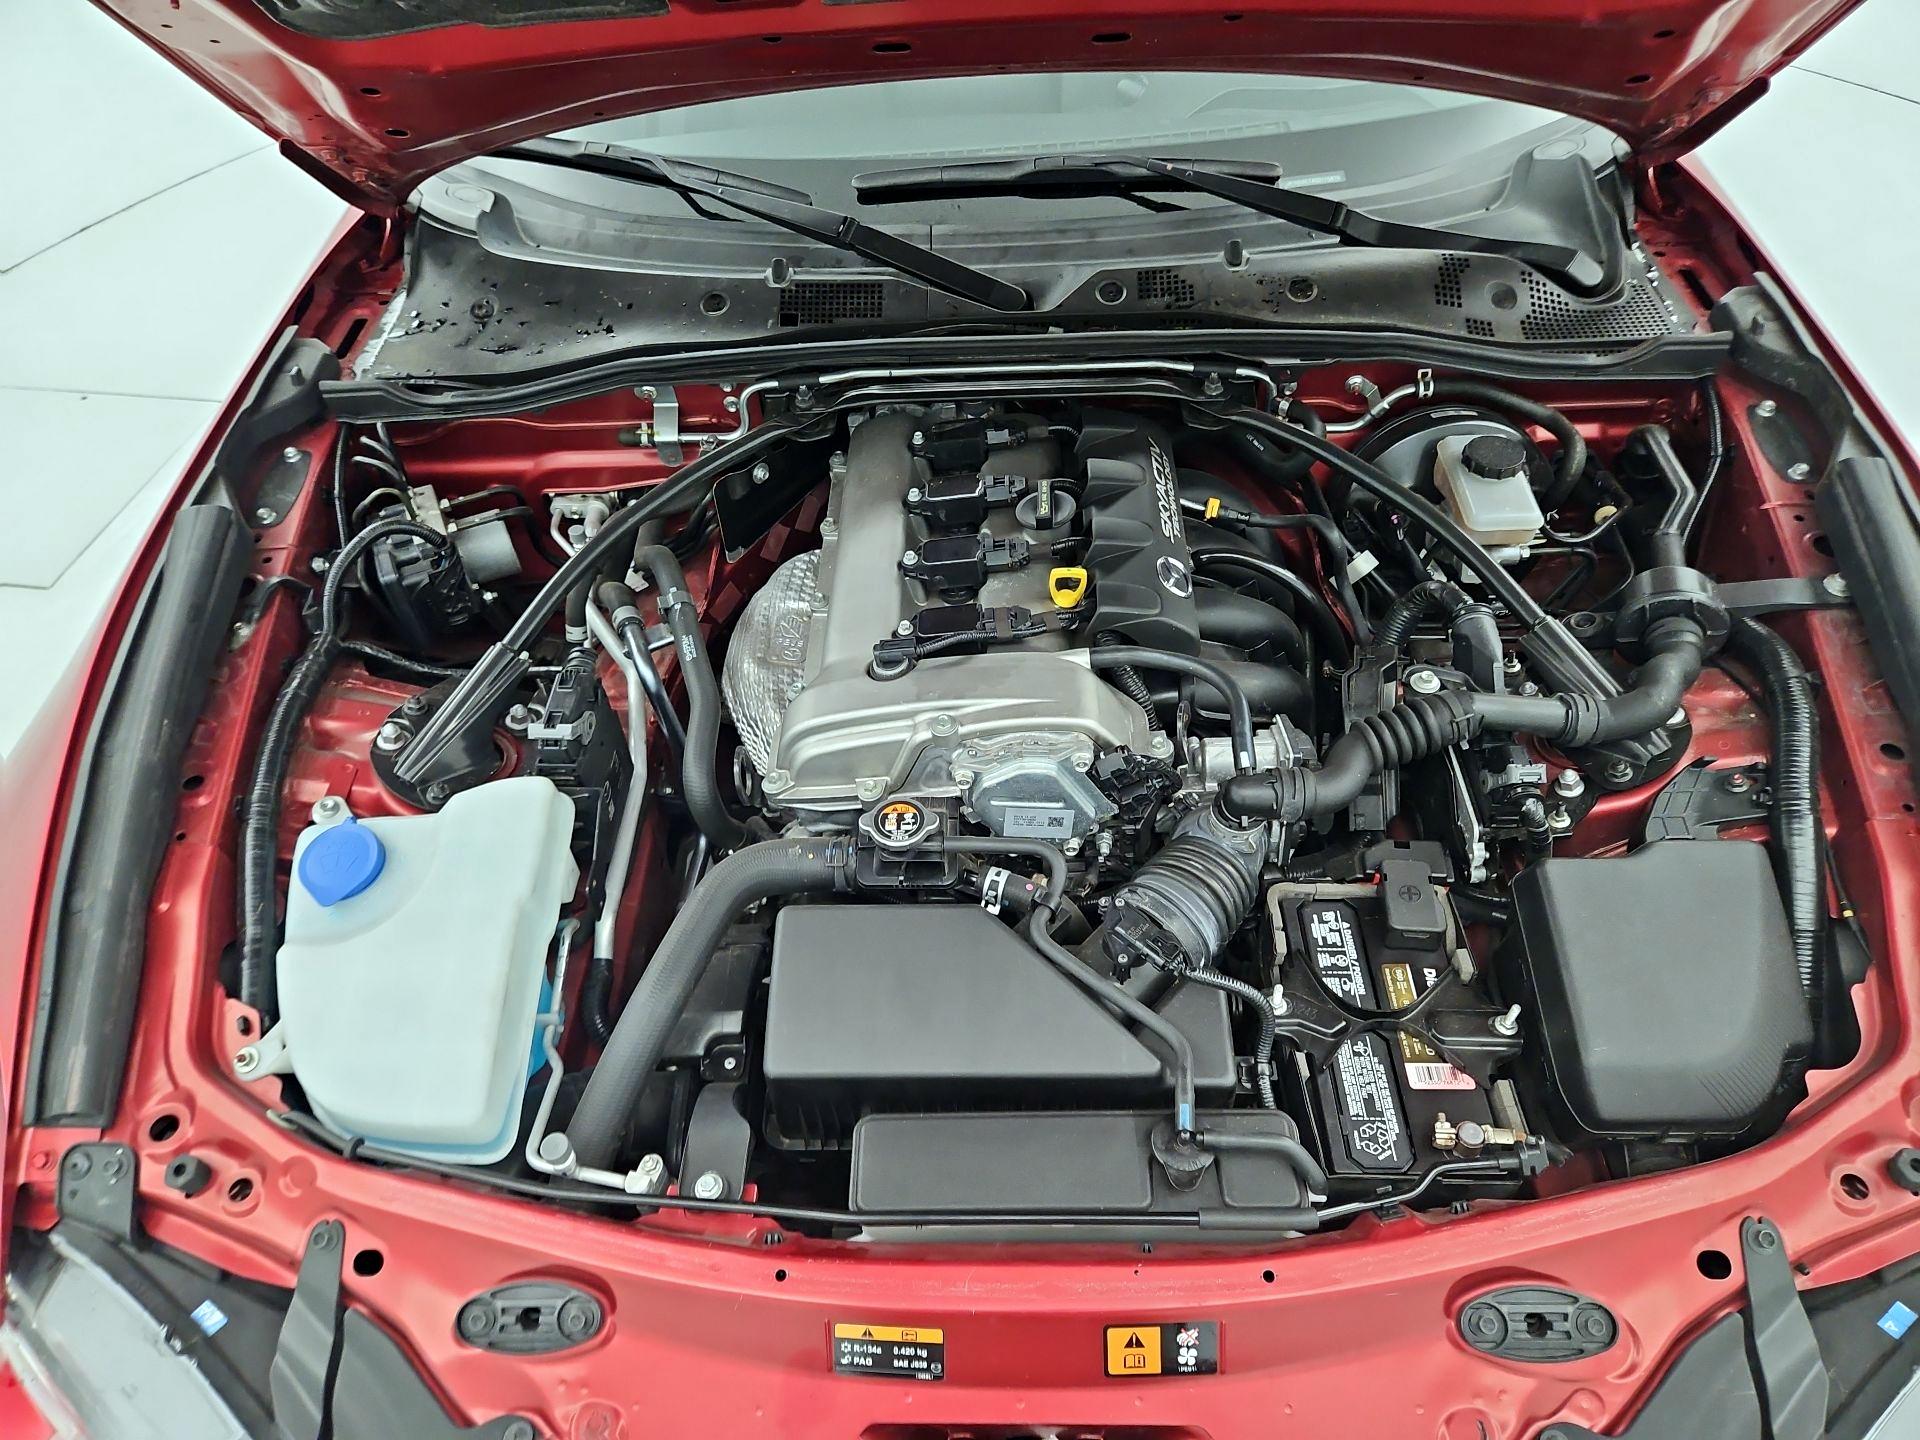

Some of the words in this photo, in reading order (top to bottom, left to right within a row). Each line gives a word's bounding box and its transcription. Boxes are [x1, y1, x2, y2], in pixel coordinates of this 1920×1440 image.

[1148, 436, 1174, 544] SKYACTIV
[1162, 451, 1181, 538] TECHNOLOGY
[1344, 930, 1358, 959] DANGER
[1352, 967, 1366, 994] POISON
[853, 1356, 873, 1367] PAG
[916, 1347, 928, 1358] kg
